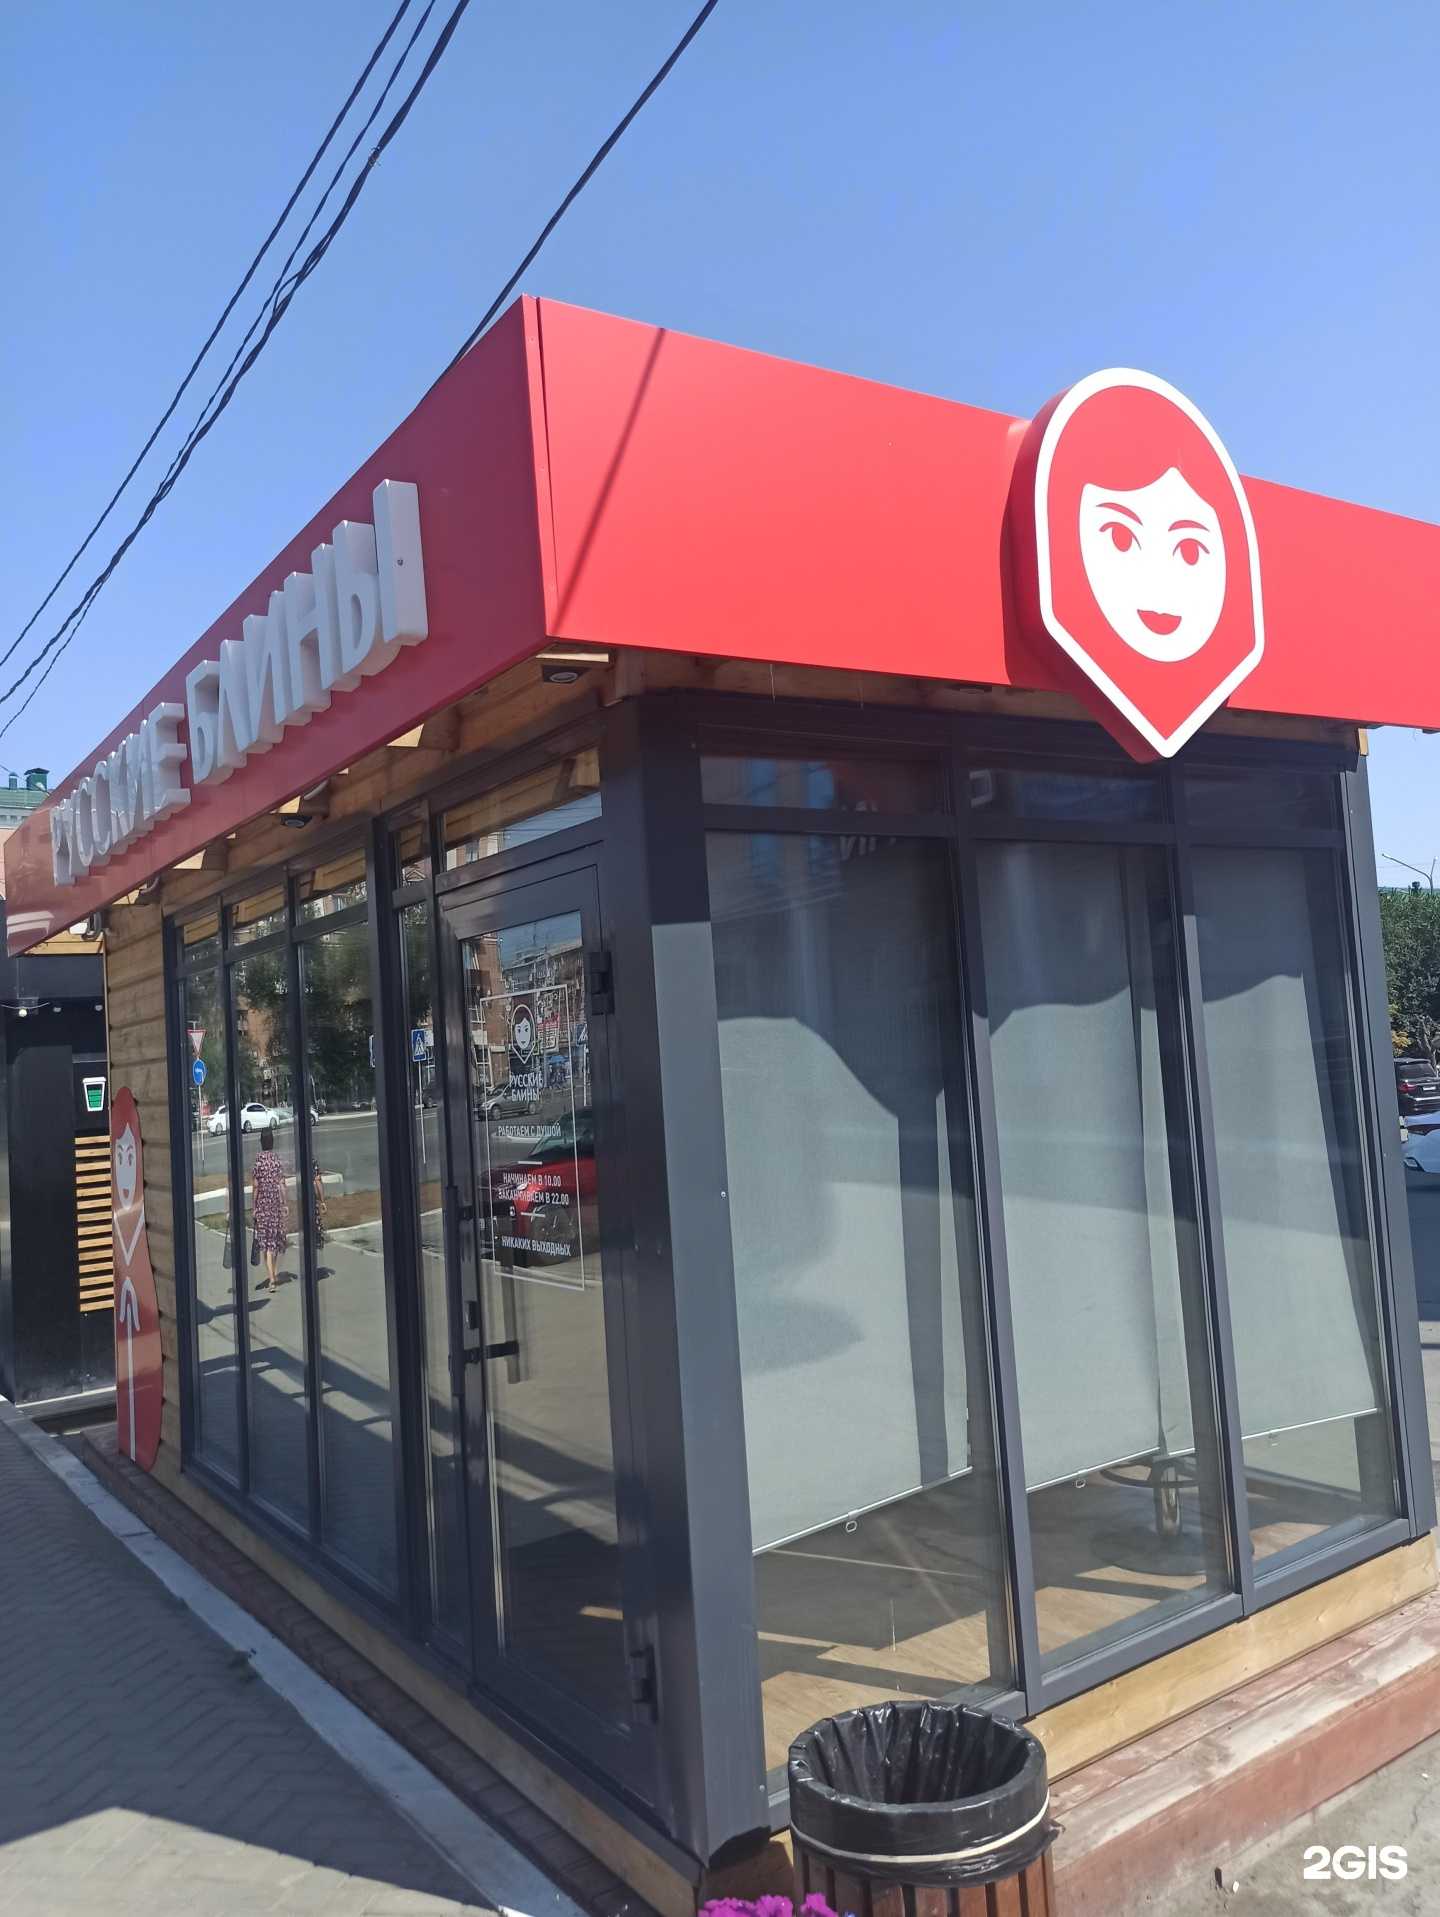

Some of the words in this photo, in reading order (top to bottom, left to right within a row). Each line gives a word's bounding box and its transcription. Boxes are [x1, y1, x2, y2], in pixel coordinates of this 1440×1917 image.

[186, 478, 429, 785] БЛИНЫ
[511, 1088, 540, 1101] БЛИНЫ
[498, 1125, 530, 1137] РАБОТАЕМ
[530, 1125, 536, 1137] С
[536, 1123, 561, 1137] ДУШОЙ
[503, 1172, 537, 1185] НАЧИНАЕМ
[538, 1174, 543, 1186] В
[544, 1175, 562, 1187] 10.00
[498, 1188, 545, 1203] ЗАКАНЧИВАЕМ
[545, 1191, 551, 1204] В
[551, 1193, 569, 1205] 22.00
[501, 1235, 531, 1250] НИКАКИХ
[531, 1239, 571, 1256] ВЫХОДНЫХ
